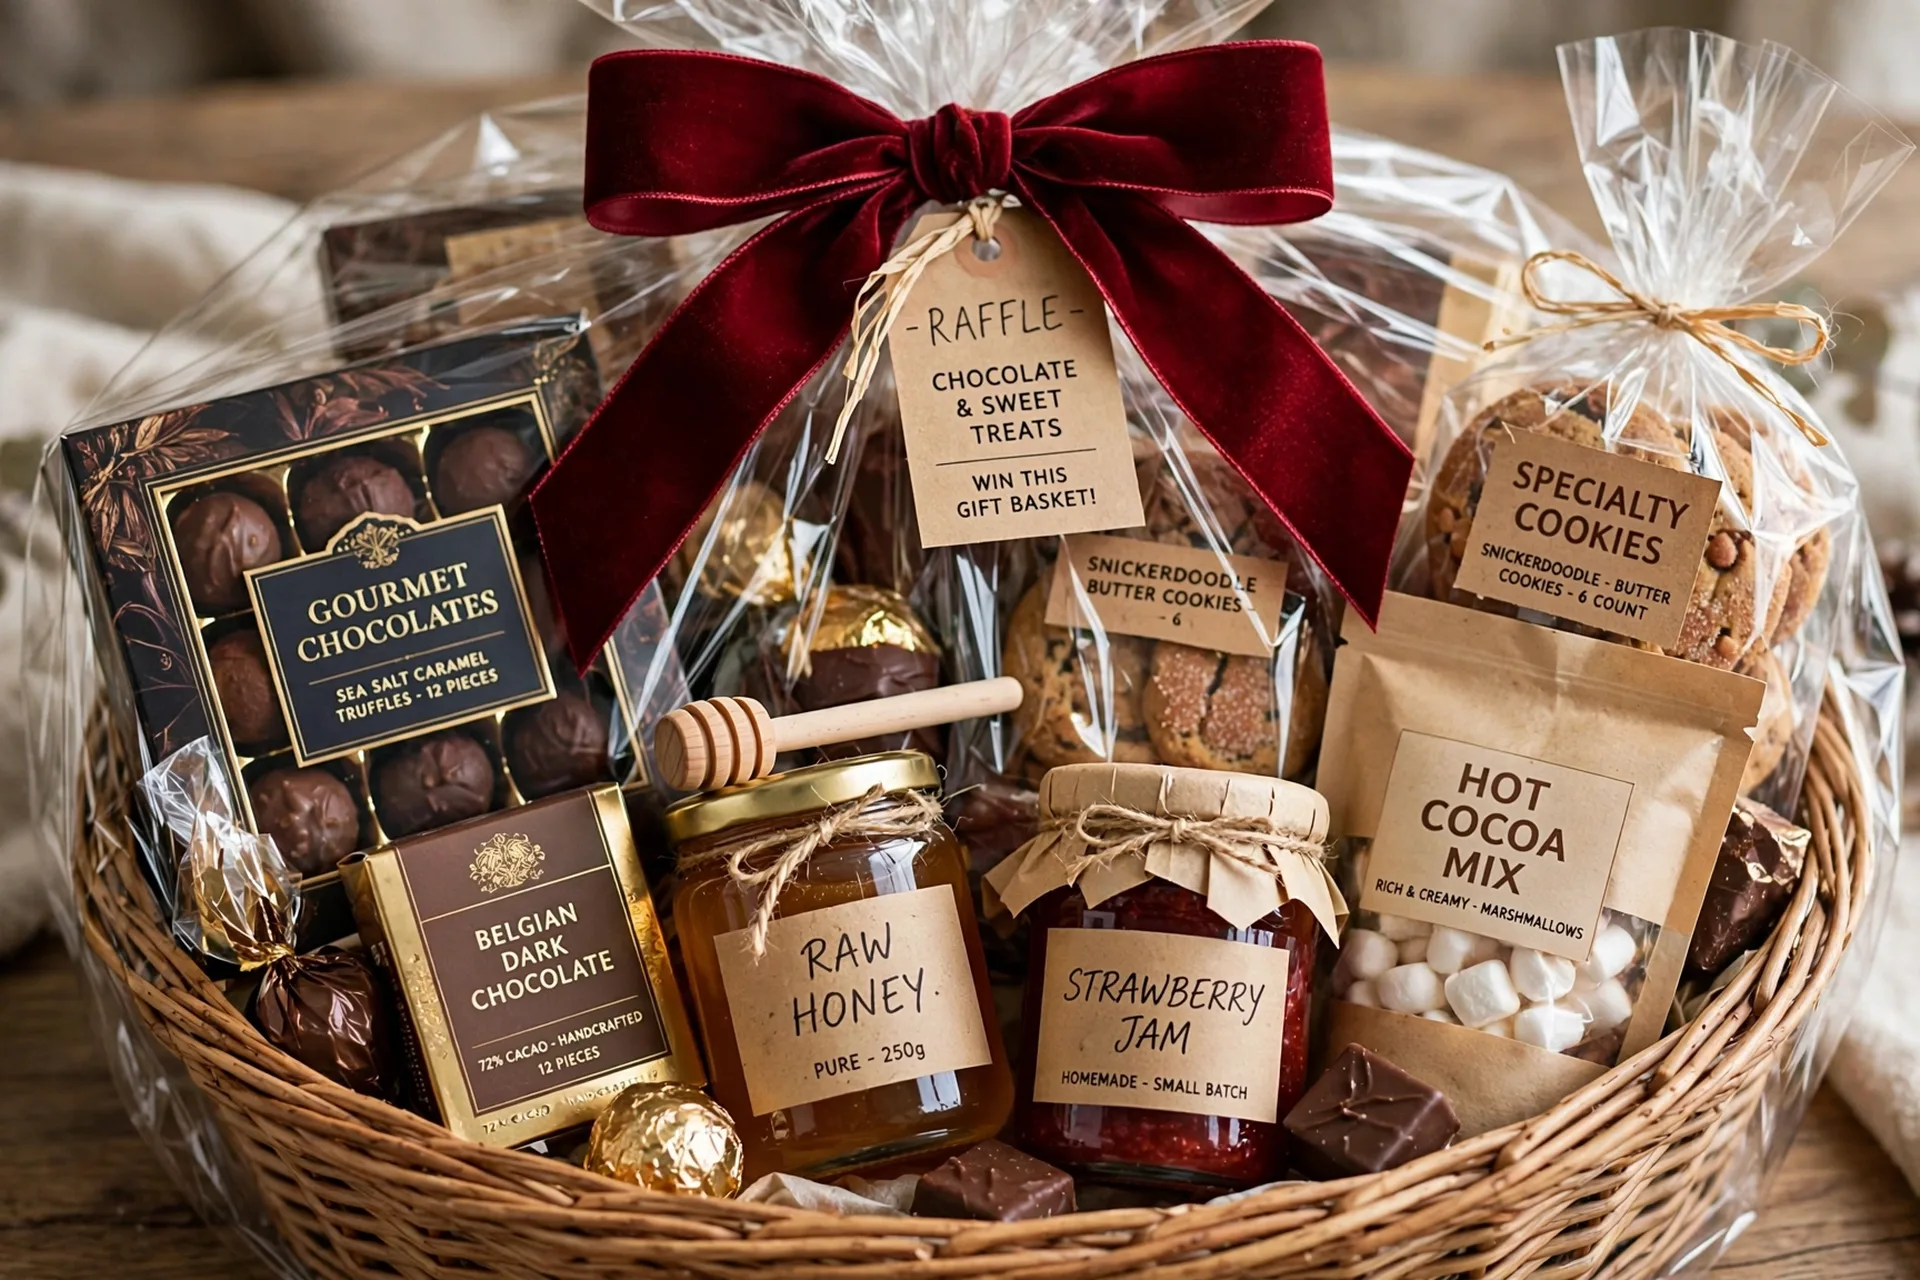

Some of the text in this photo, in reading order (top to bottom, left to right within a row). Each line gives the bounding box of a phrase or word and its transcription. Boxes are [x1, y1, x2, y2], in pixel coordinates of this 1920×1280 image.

[932, 359, 1077, 391] CHOCOLATE
[957, 389, 1061, 417] & SWEET
[970, 418, 1062, 444] TREATS
[957, 488, 1096, 518] GIFT BASKET!
[972, 467, 1067, 491] WIN THIS
[1512, 461, 1690, 530] SPECIALTY
[1515, 502, 1663, 565] COOKIES
[308, 562, 468, 625] GOURMET
[1087, 579, 1156, 602] BUTTER
[1162, 589, 1242, 613] COOKIES
[1481, 542, 1601, 587] SNICKERDOODLE
[1614, 579, 1671, 605] BUTTER
[1499, 568, 1563, 596] COOKIES
[1578, 590, 1587, 604] 6
[1593, 595, 1648, 620] COUNT
[297, 589, 499, 662] CHOCOLATES
[1172, 612, 1181, 626] 6
[335, 651, 489, 703] SEA SALT CARAMEL
[335, 693, 412, 723] TRUFFLES
[426, 684, 443, 699] 12
[446, 668, 498, 694] PIECES
[1457, 762, 1552, 811] HOT
[1421, 799, 1566, 862] COCOA
[1442, 847, 1526, 896] MIX
[475, 903, 578, 951] BELGIAN
[1375, 878, 1403, 896] RICH
[1406, 886, 1414, 898] &
[1419, 888, 1470, 910] CREAMY
[1480, 902, 1584, 940] MARSHMALLOWS
[501, 935, 569, 972] DARK
[800, 922, 891, 980] RAW
[471, 950, 614, 1011] CHOCOLATE
[1063, 968, 1265, 1026] STRAWBERRY
[477, 1055, 503, 1072] 72%
[505, 1041, 548, 1063] CACAO
[558, 1010, 643, 1047] HANDCRAFTED
[1114, 1015, 1190, 1055] JAM
[538, 1046, 600, 1075] 12 PIECES
[813, 1054, 861, 1079] PURE
[881, 1042, 925, 1063] 250g
[1062, 1071, 1137, 1088] HOMEMADE
[1154, 1077, 1200, 1095] SMALL
[1206, 1083, 1247, 1099] BATCH
